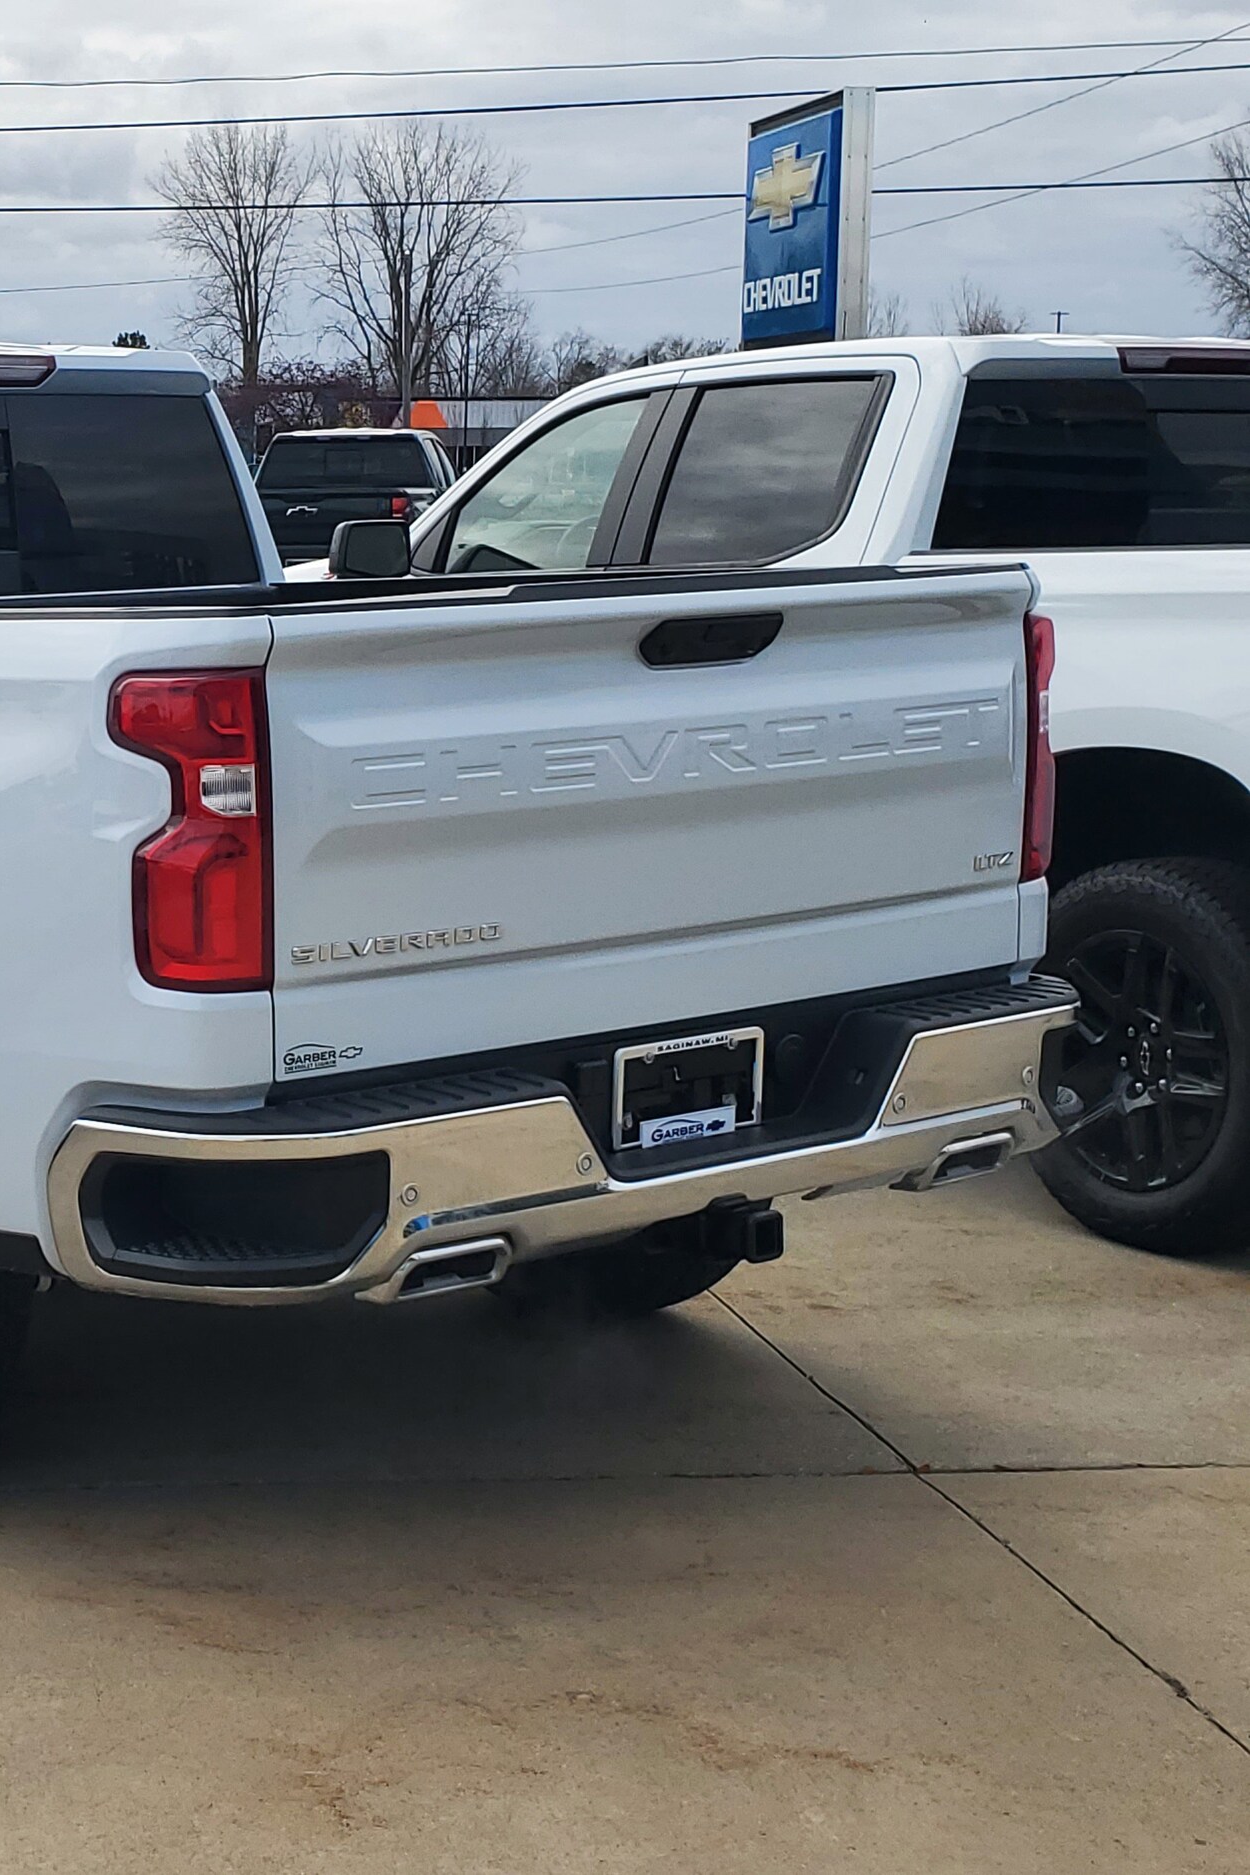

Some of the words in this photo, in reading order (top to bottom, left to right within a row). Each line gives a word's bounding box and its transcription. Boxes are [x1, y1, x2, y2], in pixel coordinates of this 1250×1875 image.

[743, 267, 821, 314] CHEVROLET
[350, 697, 999, 810] CHEVROLET
[973, 851, 1014, 872] LTZ
[291, 921, 501, 965] SILVERADO
[283, 1050, 337, 1066] GARBER
[651, 1123, 705, 1142] GARBER
